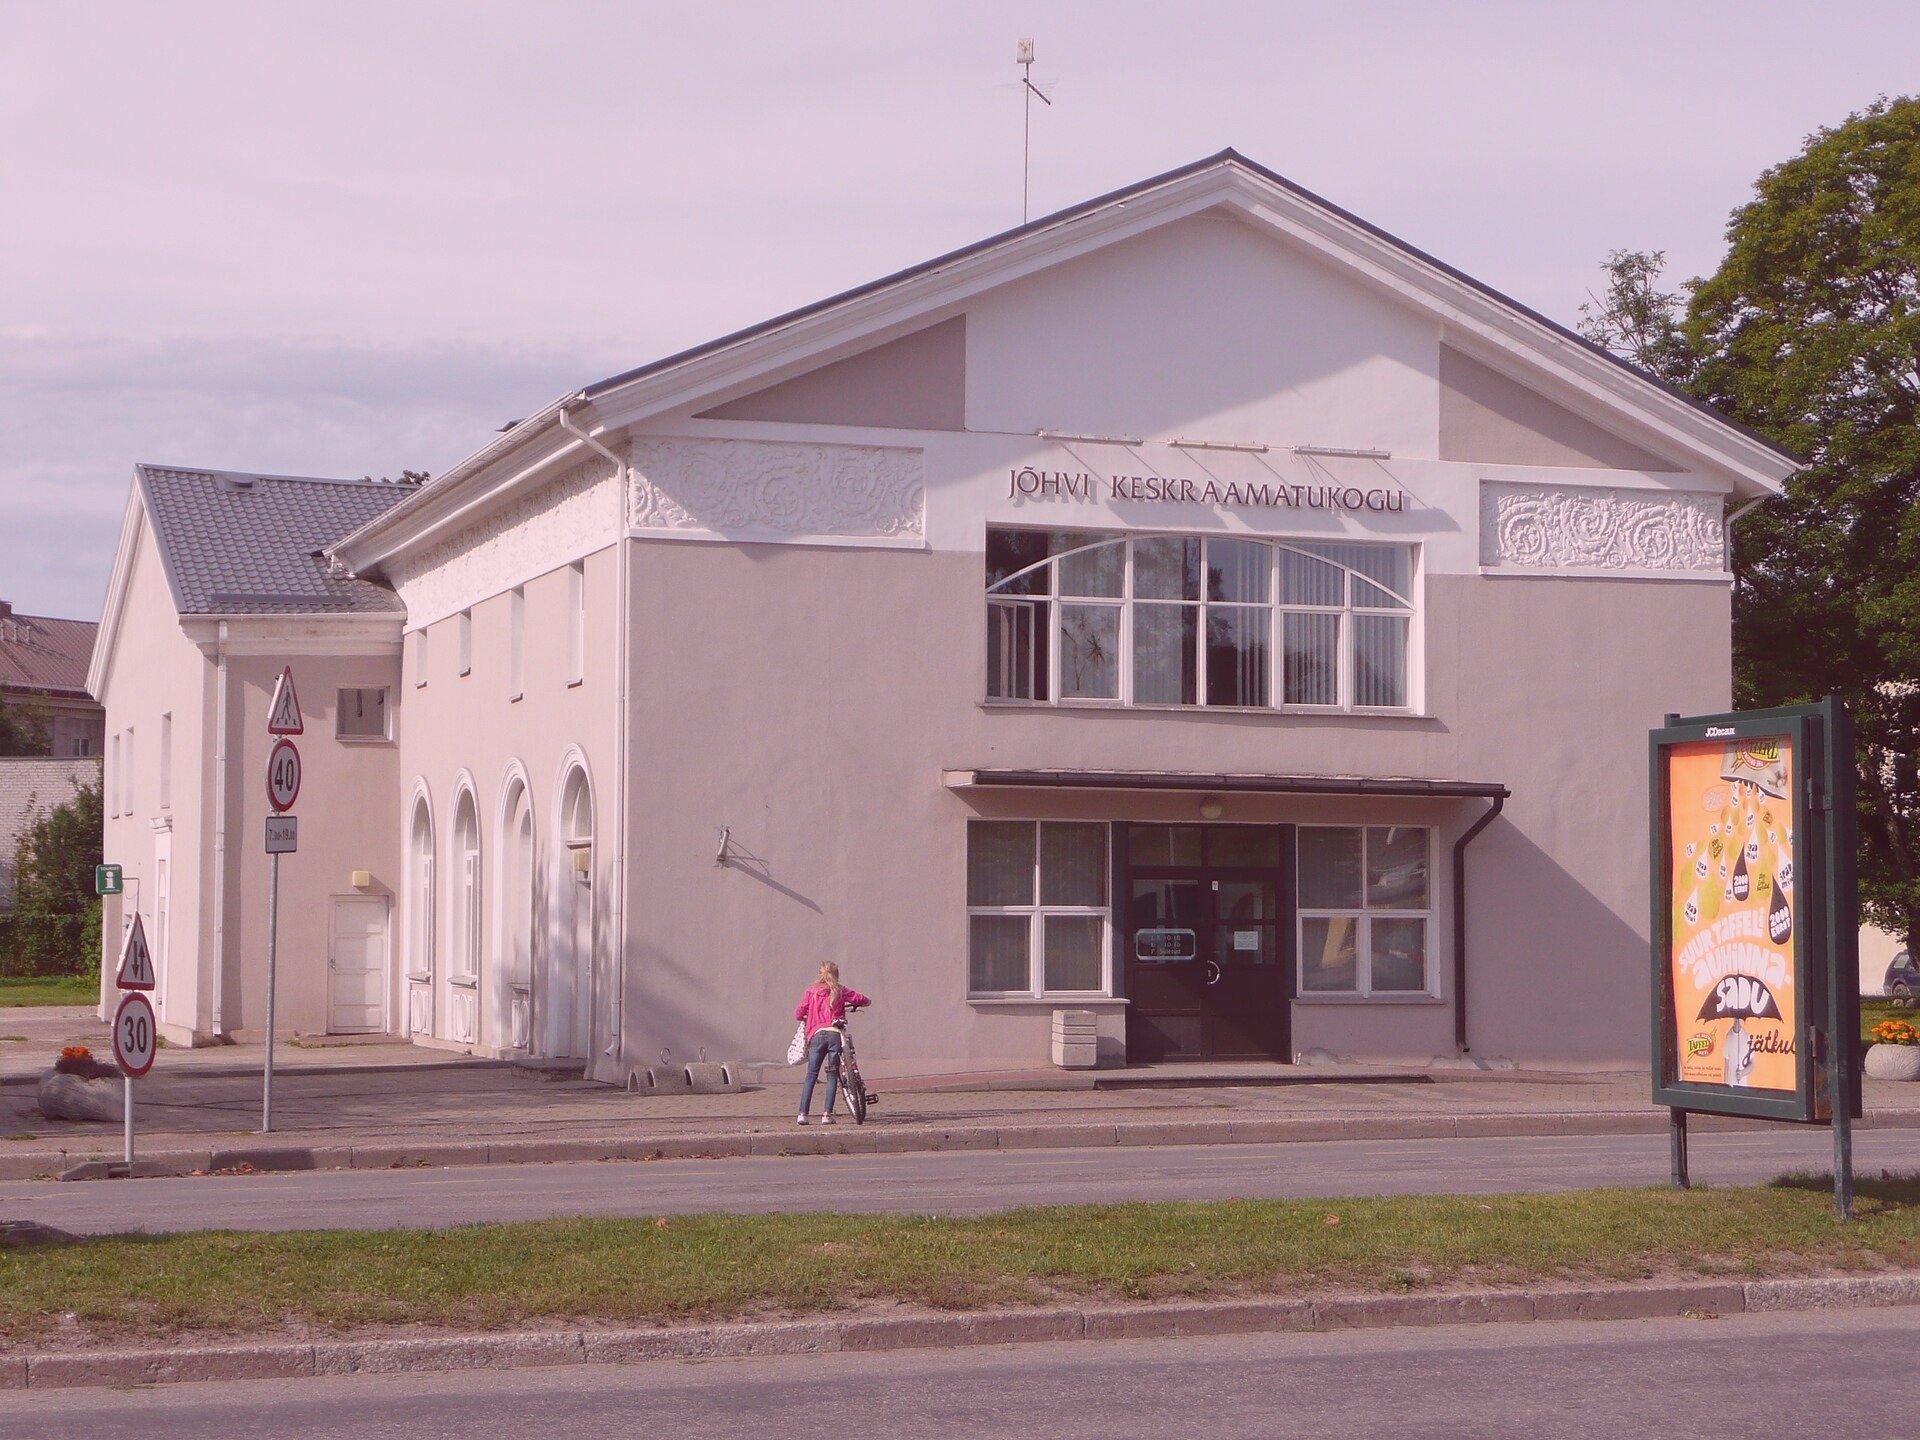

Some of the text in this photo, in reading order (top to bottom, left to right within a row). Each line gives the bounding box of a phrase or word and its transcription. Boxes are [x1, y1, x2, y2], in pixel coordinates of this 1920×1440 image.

[1008, 466, 1403, 512] JÕHVI KESKRAAMATUKOGU
[1705, 727, 1735, 737] JCDecaux
[275, 759, 294, 791] 40
[1734, 874, 1748, 886] 2000
[1769, 906, 1789, 928] 2000
[1770, 917, 1791, 938] EUROT
[1679, 929, 1716, 974] SUUR
[124, 1015, 147, 1054] 30
